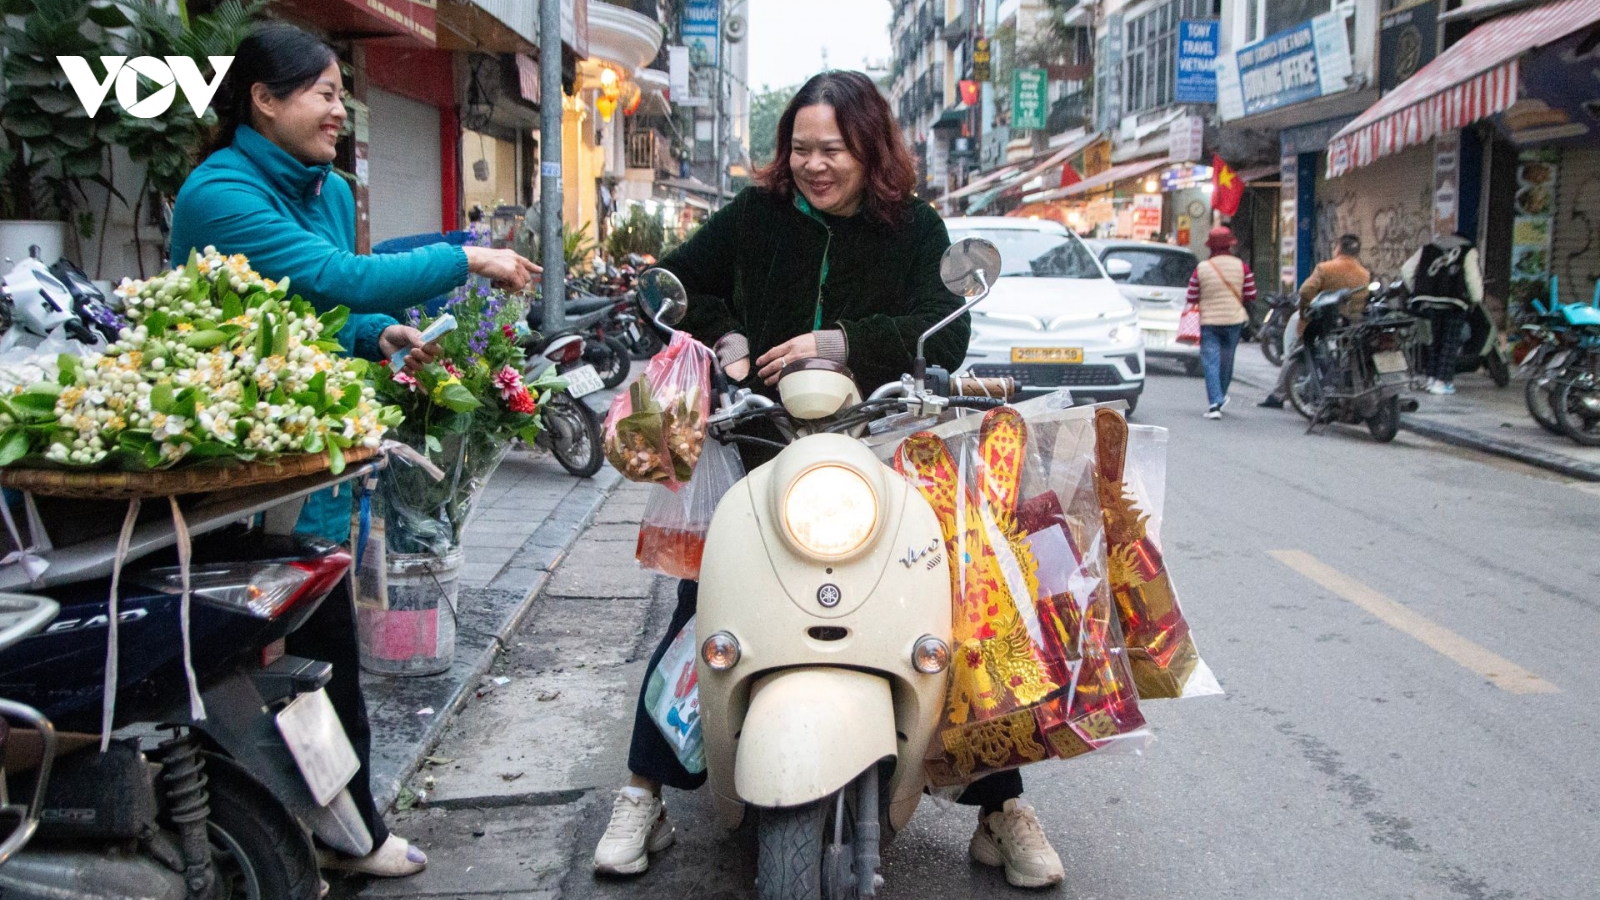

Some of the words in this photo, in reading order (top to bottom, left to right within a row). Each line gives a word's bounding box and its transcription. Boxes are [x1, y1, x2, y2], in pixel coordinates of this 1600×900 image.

[1188, 23, 1211, 38] TONY
[1183, 40, 1215, 56] TRAVEL
[1280, 50, 1318, 91] OFFICE
[45, 607, 149, 634] EAD
